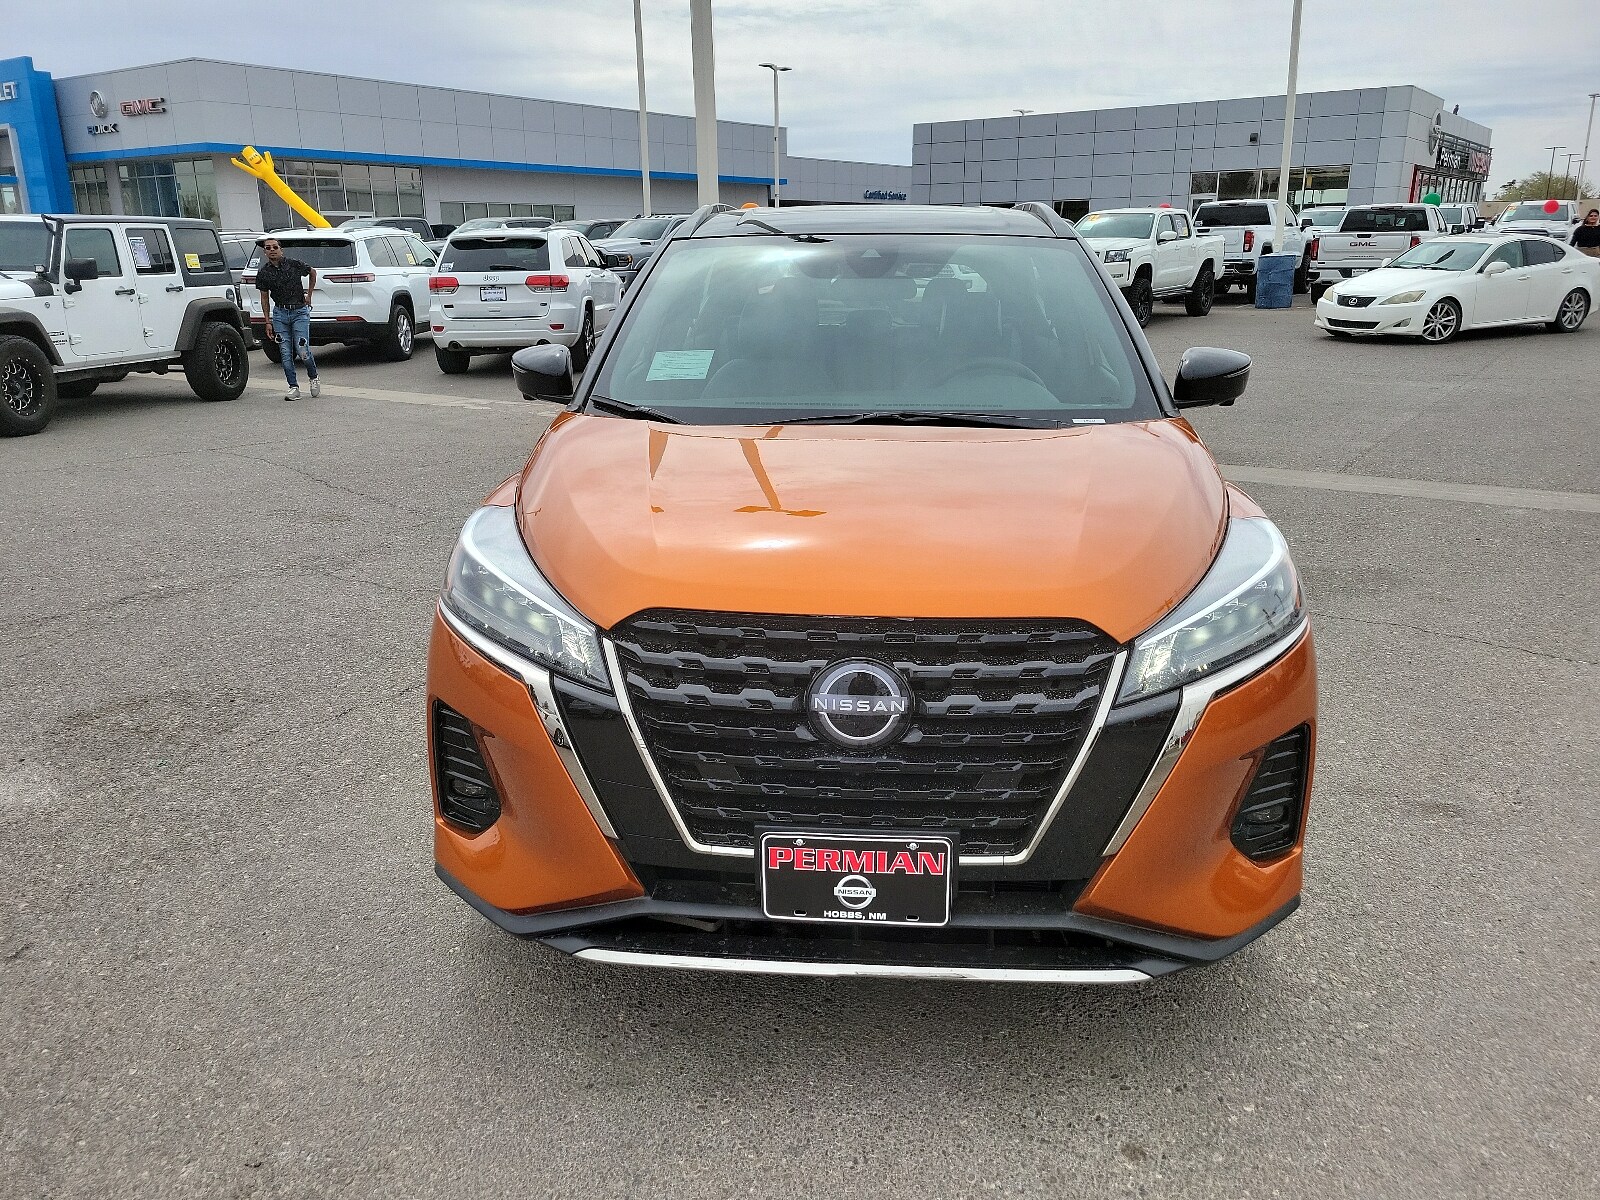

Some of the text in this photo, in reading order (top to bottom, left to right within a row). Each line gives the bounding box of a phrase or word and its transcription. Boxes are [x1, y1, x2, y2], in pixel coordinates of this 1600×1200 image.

[120, 98, 166, 116] GMC
[87, 123, 119, 136] BUICK
[814, 697, 906, 713] NISSAN
[767, 846, 945, 876] PERMIAN
[837, 888, 873, 897] NISSAN
[823, 909, 887, 921] HOBBS, NM
